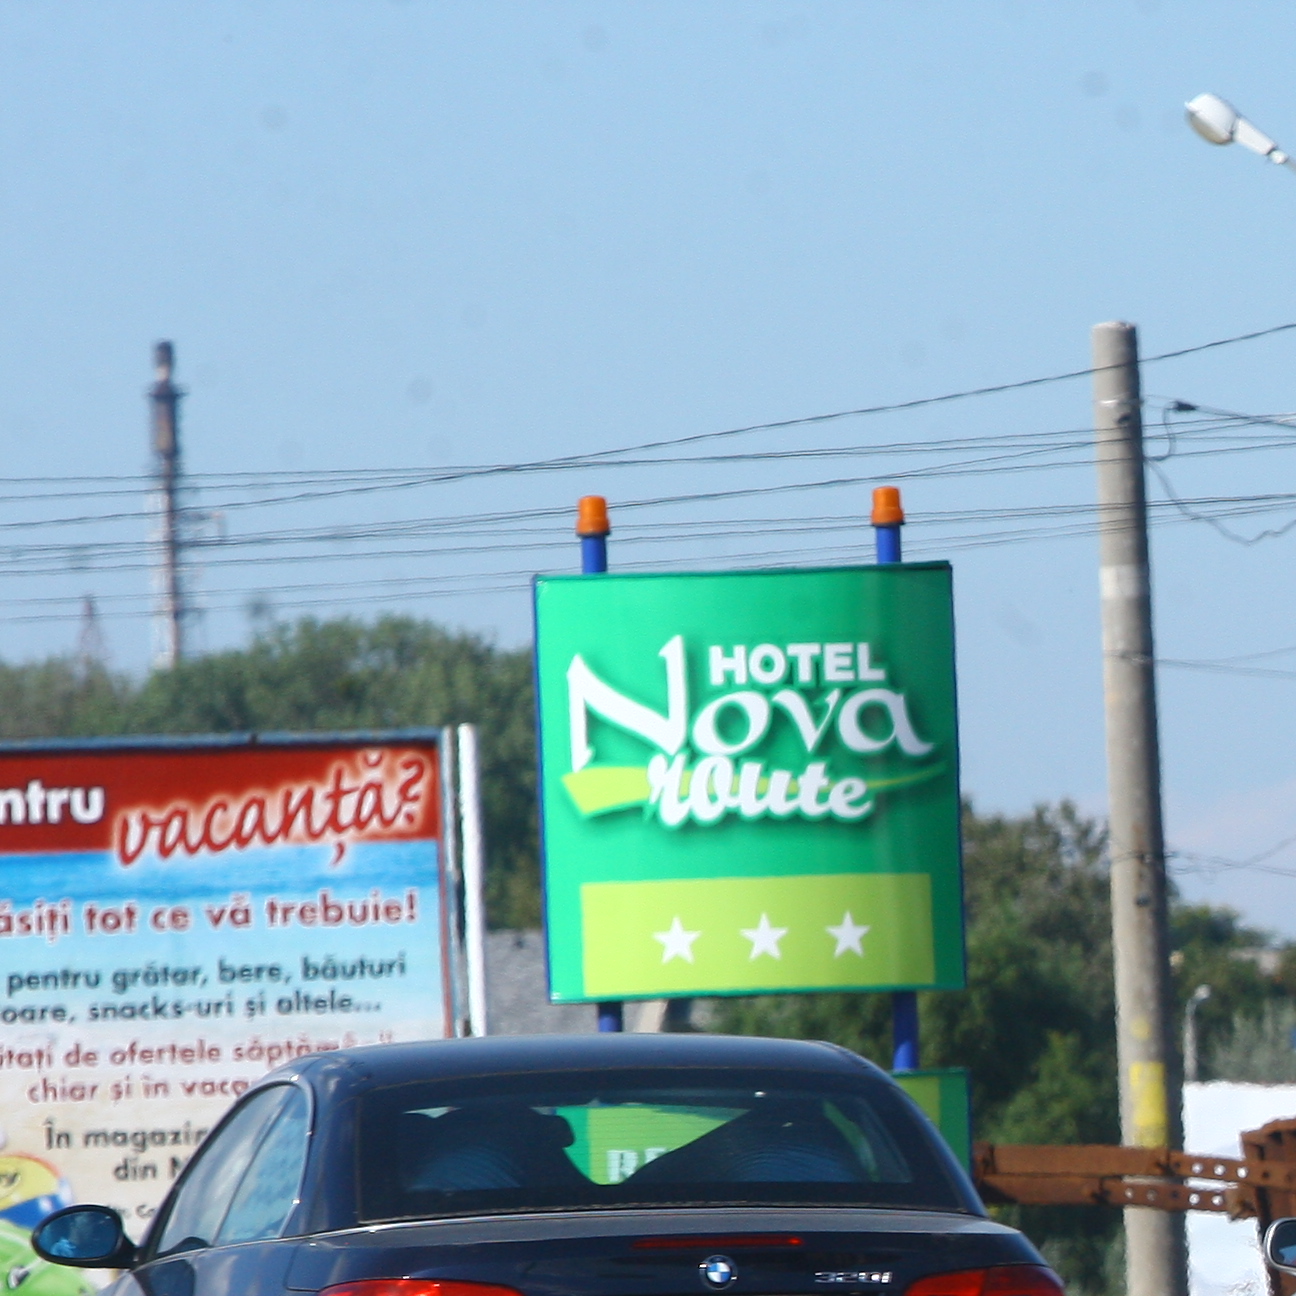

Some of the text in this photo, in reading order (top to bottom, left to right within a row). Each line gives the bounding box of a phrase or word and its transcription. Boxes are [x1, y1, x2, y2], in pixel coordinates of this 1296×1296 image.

[709, 642, 886, 685] HOTEL
[566, 634, 935, 773] Nova
[85, 904, 137, 932] tot
[152, 908, 190, 931] ce
[205, 896, 251, 926] vă
[267, 890, 416, 926] trebuie!
[8, 951, 406, 998] pentru grătar, bere, băuturi
[1, 1004, 75, 1023] oare,
[89, 991, 233, 1020] snacks-uri
[277, 988, 381, 1015] altele...
[64, 1042, 98, 1066] de
[109, 1039, 221, 1065] ofertele
[27, 1076, 98, 1104] chiar
[142, 1073, 170, 1098] în
[43, 1116, 70, 1149] În
[114, 1158, 157, 1180] din
